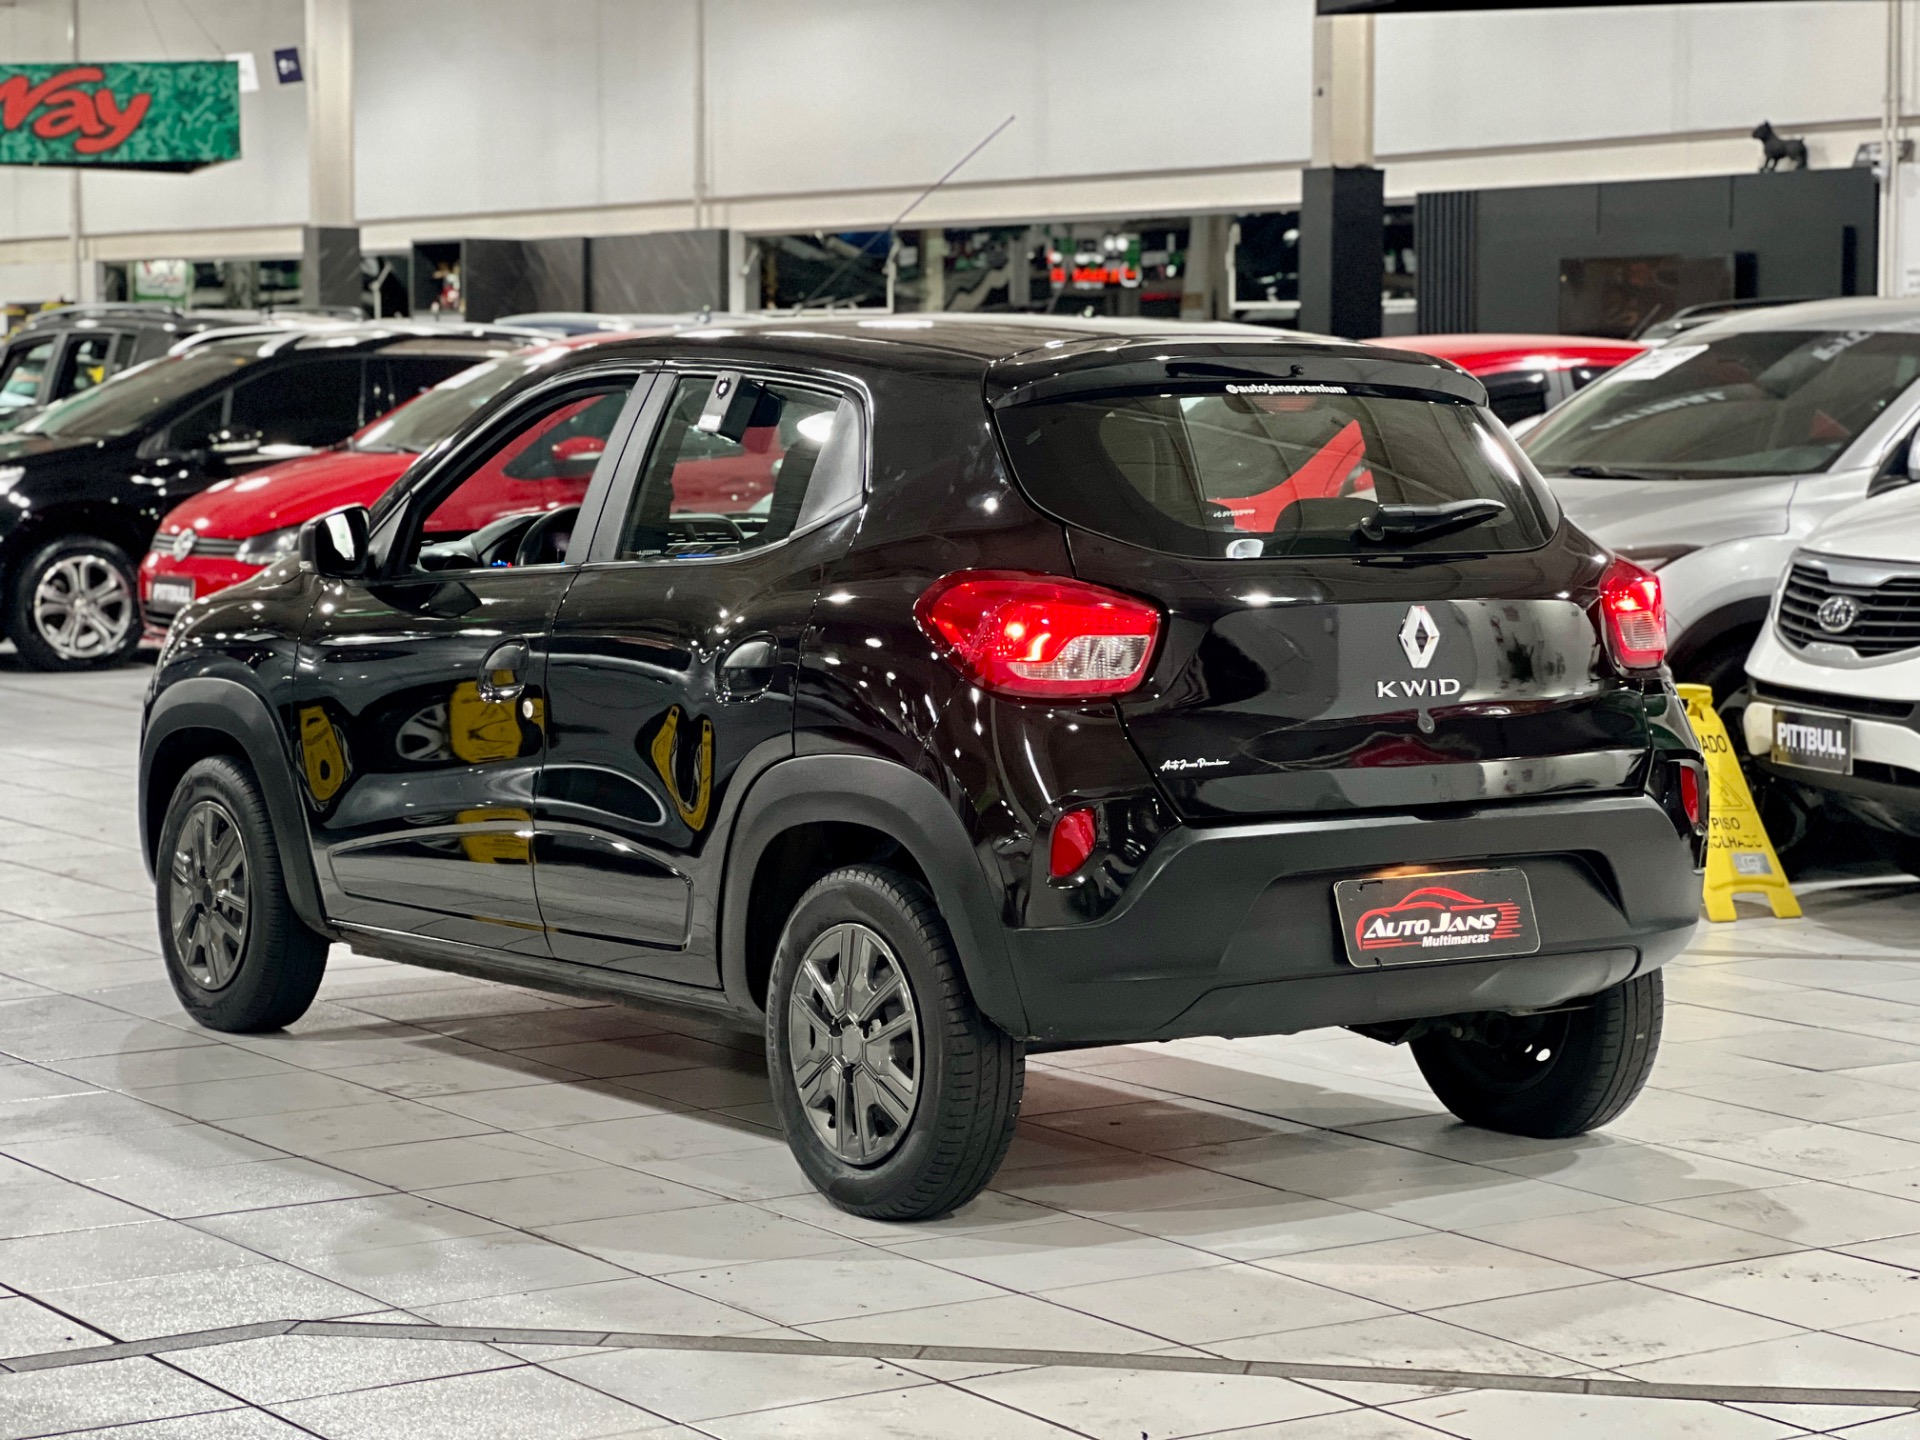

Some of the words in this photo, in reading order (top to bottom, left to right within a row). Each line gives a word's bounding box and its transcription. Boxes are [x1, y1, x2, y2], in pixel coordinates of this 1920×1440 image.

[1225, 383, 1348, 395] @autojanspremium
[1376, 678, 1460, 698] KWID
[1776, 722, 1847, 755] PITTBULL
[1710, 817, 1741, 830] PISO
[1363, 917, 1430, 939] AUTO
[1430, 912, 1498, 933] JANS
[1421, 933, 1490, 948] Multimarcas
